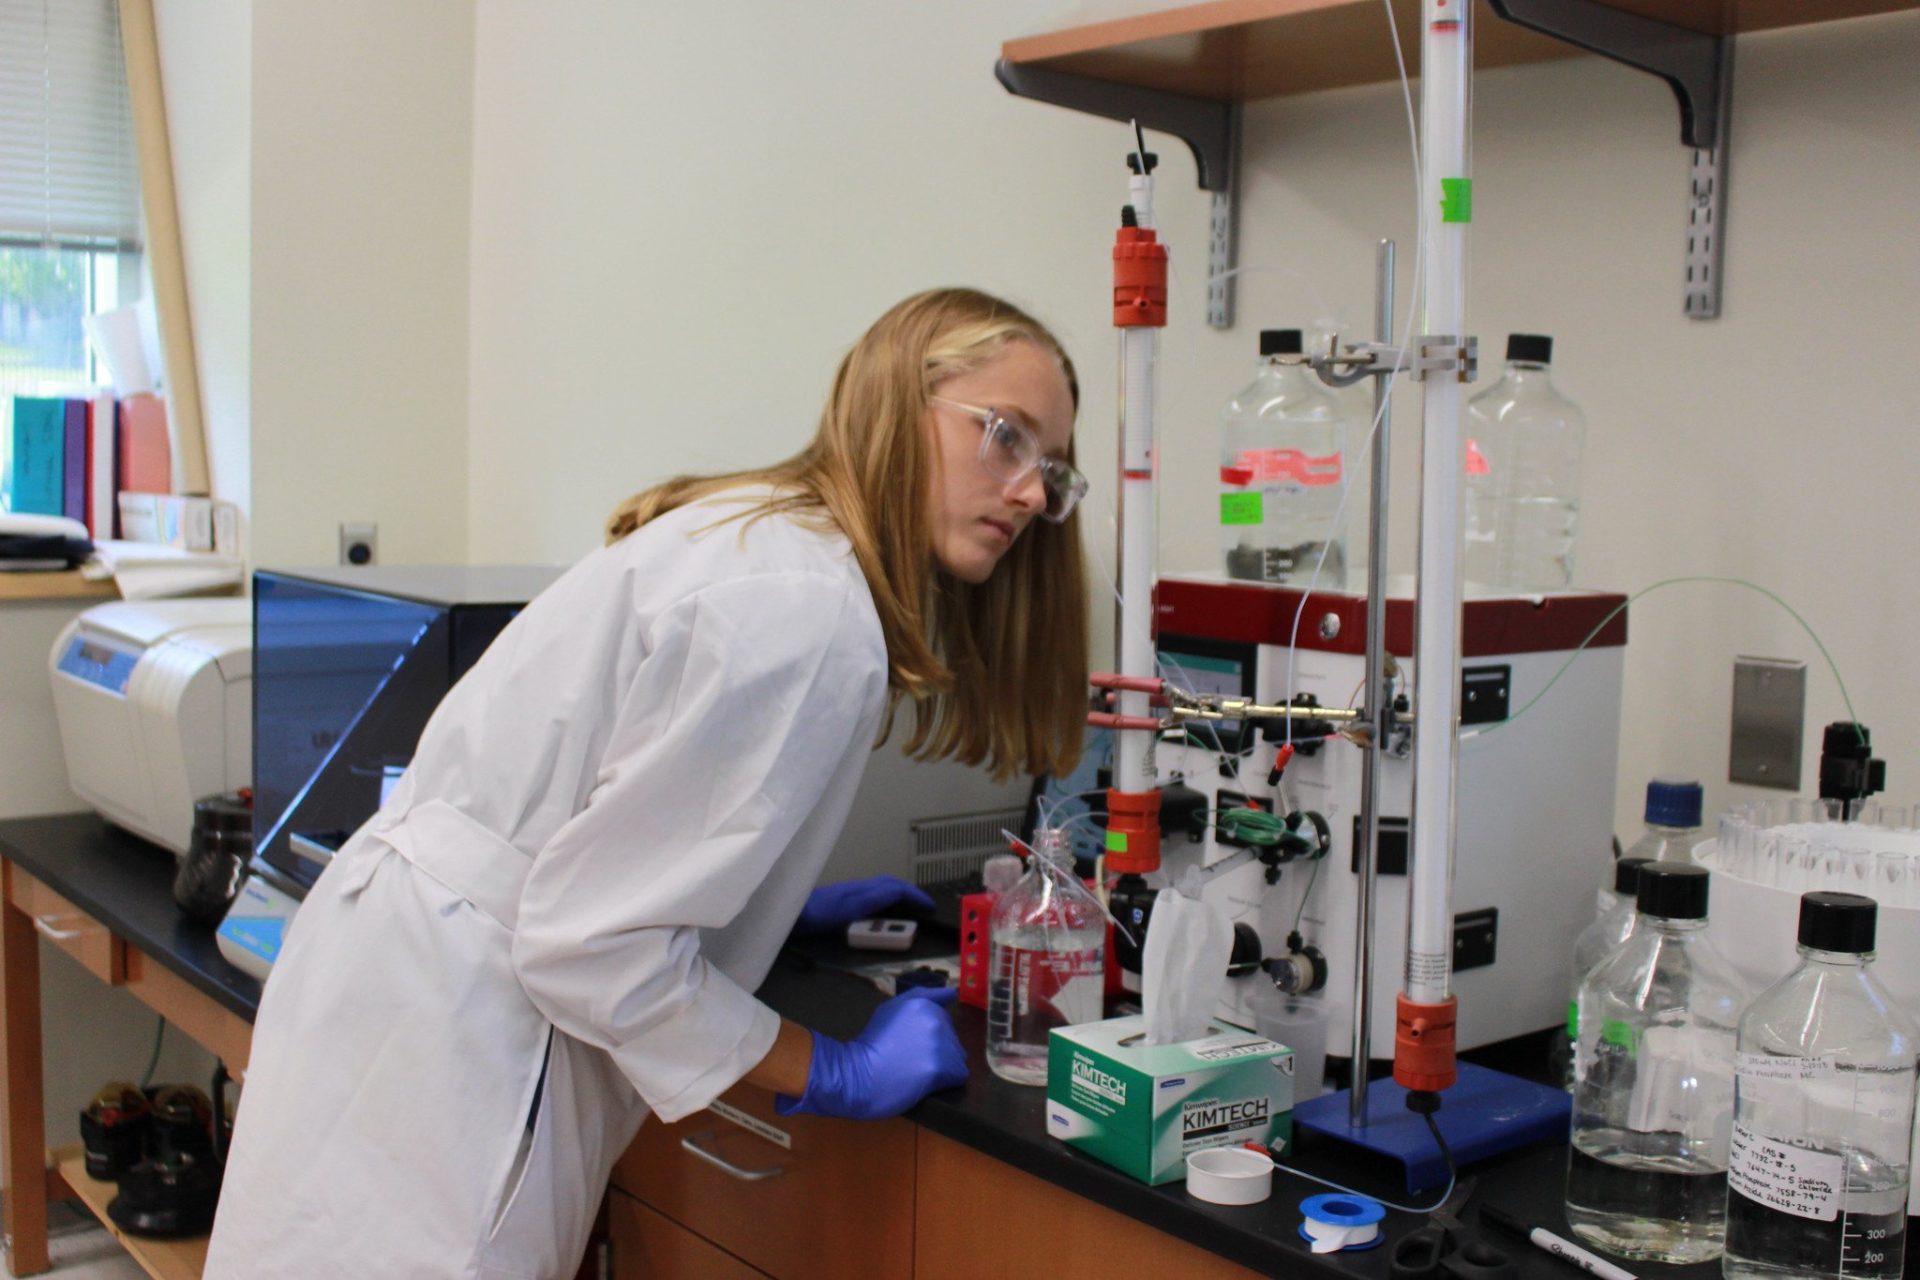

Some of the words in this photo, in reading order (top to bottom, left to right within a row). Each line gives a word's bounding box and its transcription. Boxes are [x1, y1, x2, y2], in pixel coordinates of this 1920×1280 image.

[1072, 1059, 1127, 1097] KIMTECH
[1183, 1098, 1268, 1131] KIMTECH
[1867, 1229, 1886, 1240] 300
[1865, 1252, 1884, 1264] 200
